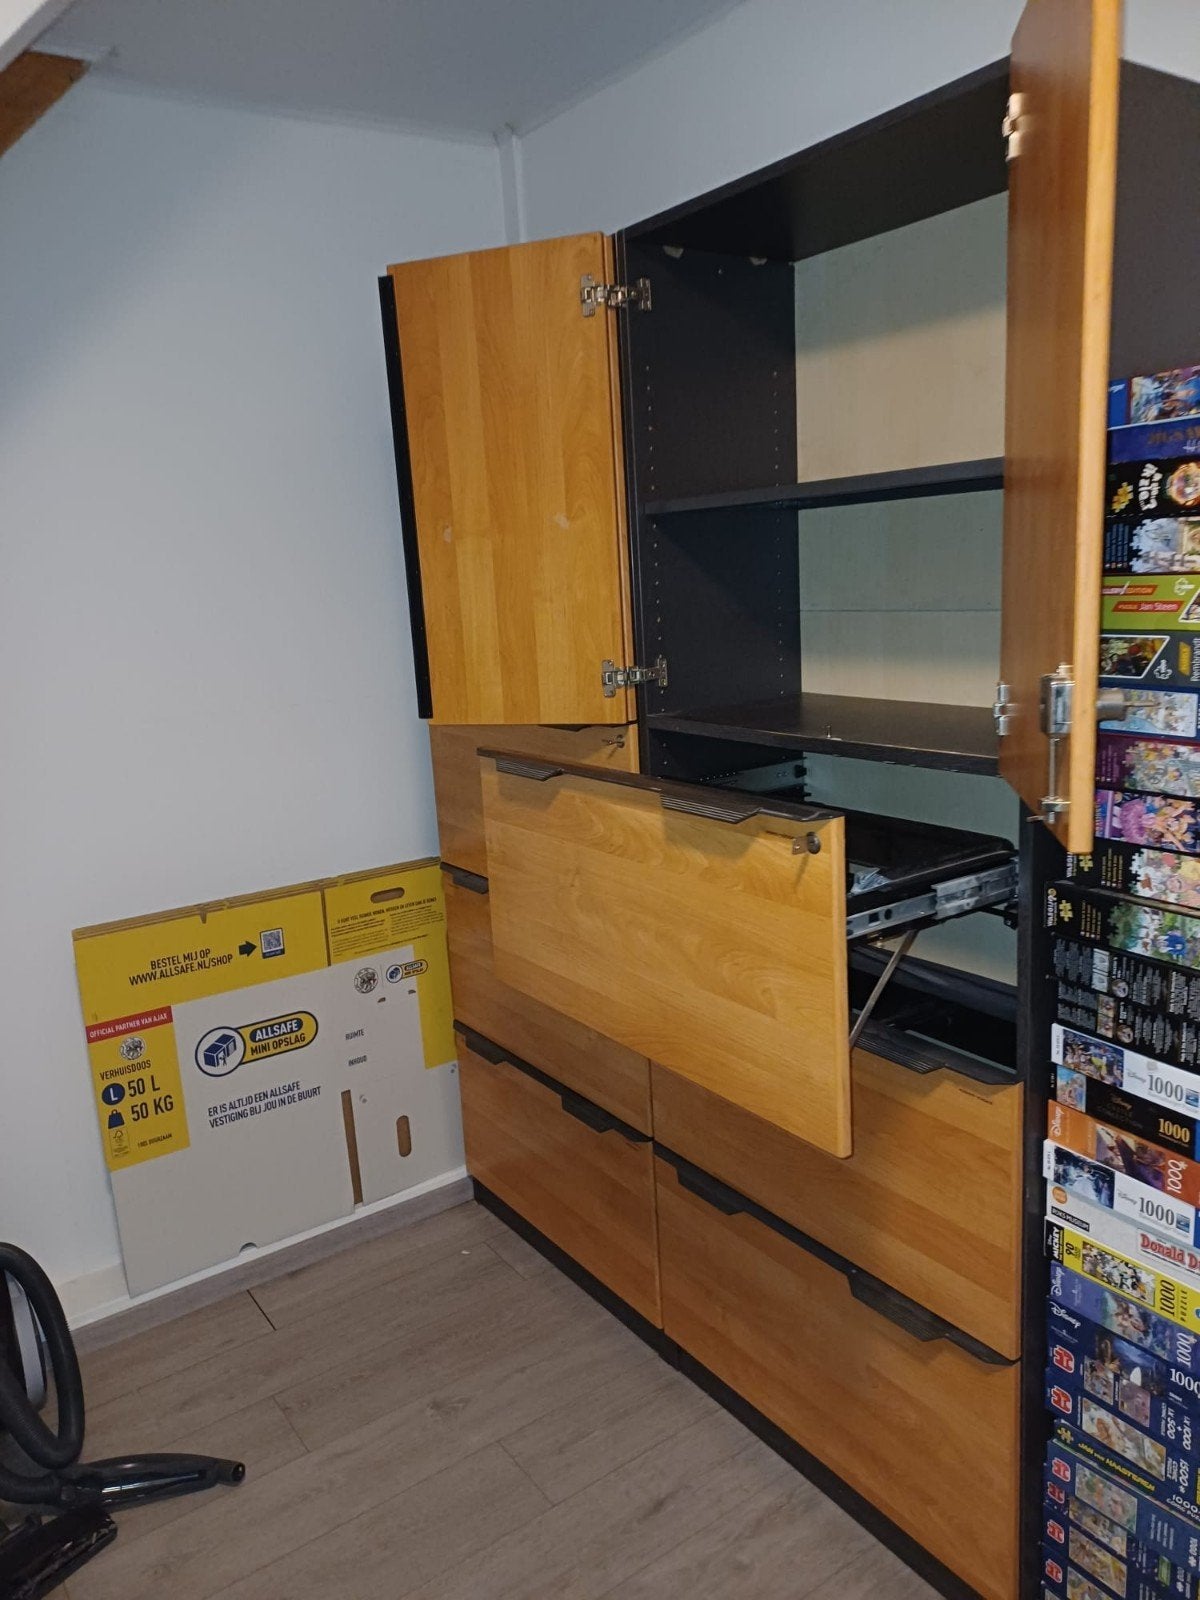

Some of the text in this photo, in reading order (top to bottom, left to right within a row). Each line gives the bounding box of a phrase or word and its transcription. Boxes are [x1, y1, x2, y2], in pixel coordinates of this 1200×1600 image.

[129, 954, 233, 986] WWW.ALLSAFE.NL/SHOP
[150, 948, 211, 970] BESTEL MIJ OP
[89, 1012, 168, 1038] OFFICIAL PARTNER VAN AJAX
[255, 1020, 298, 1041] ALLSAFE
[250, 1033, 306, 1056] MINI OPSLAG
[100, 1060, 151, 1081] VERHUISDOOS
[109, 1075, 161, 1101] L 50 L
[208, 1081, 300, 1117] ER IS ALTIJD EEN ALLSAFE
[1148, 1075, 1183, 1102] 1000
[131, 1095, 174, 1122] 50 KG
[209, 1086, 321, 1129] VESTIGING BIJ JOU IN DE BUURT
[1050, 1107, 1064, 1137] Disney
[1158, 1118, 1190, 1143] 1000
[1167, 1159, 1185, 1194] 1000
[1139, 1197, 1174, 1225] 1000
[1140, 1233, 1186, 1266] Donald
[1051, 1267, 1064, 1296] Disney
[1160, 1280, 1176, 1317] 1000
[1180, 1289, 1188, 1323] PUZZLE
[1050, 1302, 1081, 1329] Disney
[1177, 1332, 1193, 1368] 1000
[1167, 1419, 1176, 1440] 500
[1182, 1424, 1193, 1451] 1000
[1179, 1458, 1190, 1487] 1500
[1172, 1494, 1198, 1514] 1000
